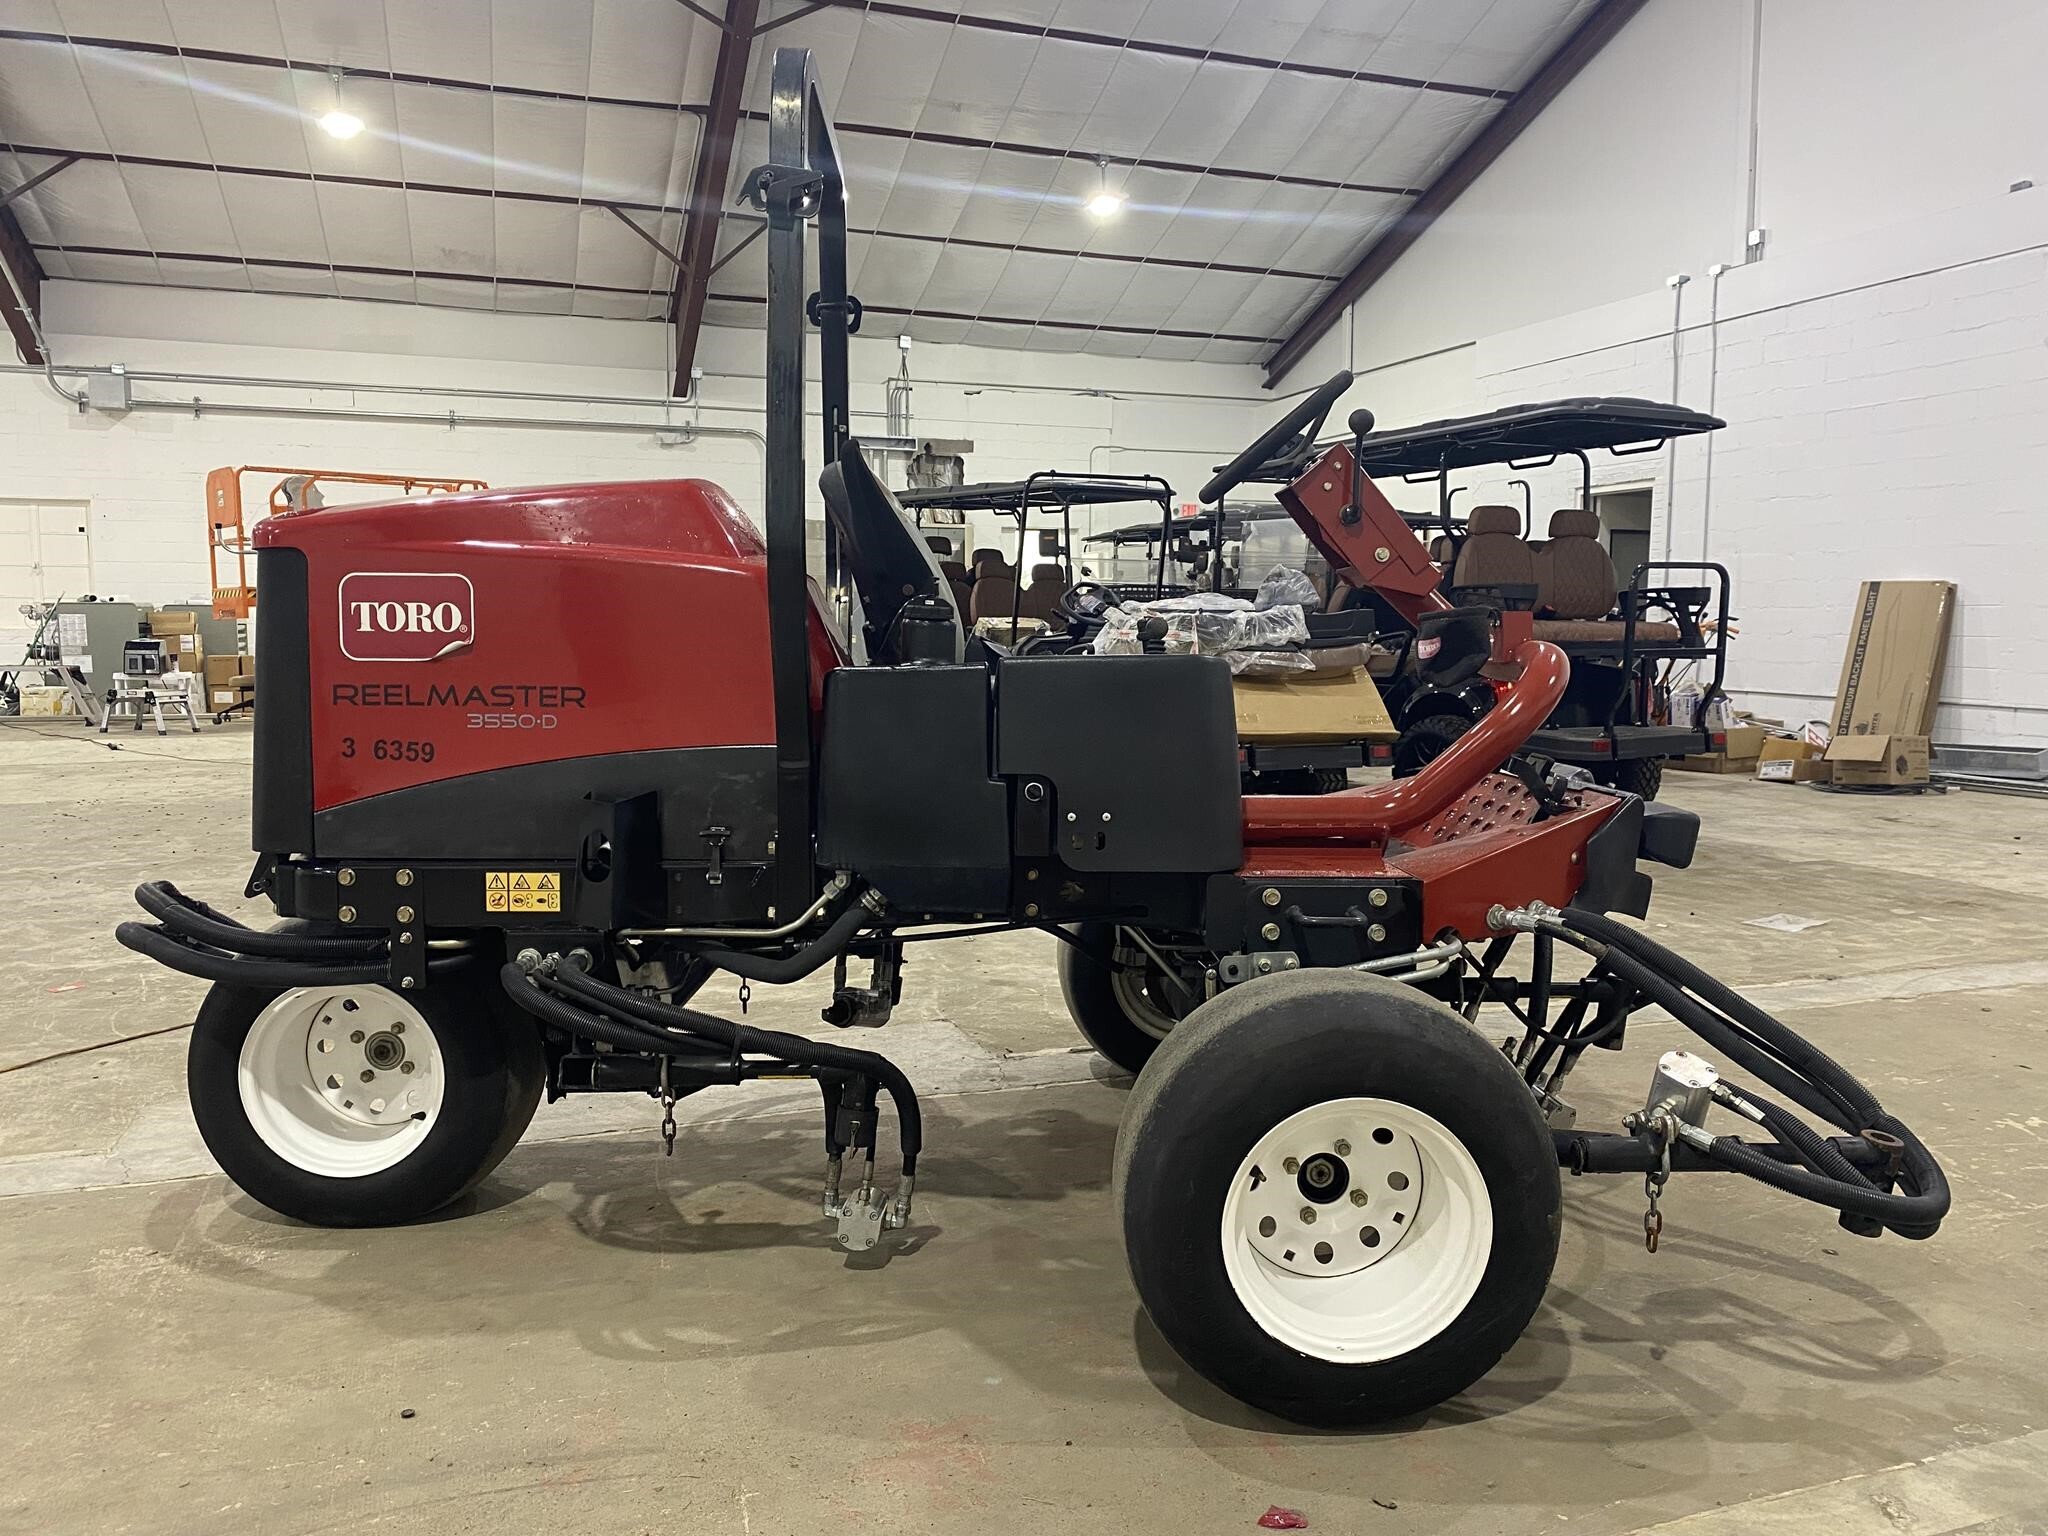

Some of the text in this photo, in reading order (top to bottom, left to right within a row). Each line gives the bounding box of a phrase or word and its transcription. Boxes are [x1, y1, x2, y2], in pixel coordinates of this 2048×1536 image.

[351, 601, 462, 632] TORO
[1841, 688, 1856, 726] PREMIUM
[1849, 646, 1865, 686] BACK-LIT
[1858, 619, 1871, 645] PANEL
[1865, 591, 1877, 616] LIGHT
[332, 684, 586, 708] REELMASTER
[341, 737, 435, 763] 3 6359
